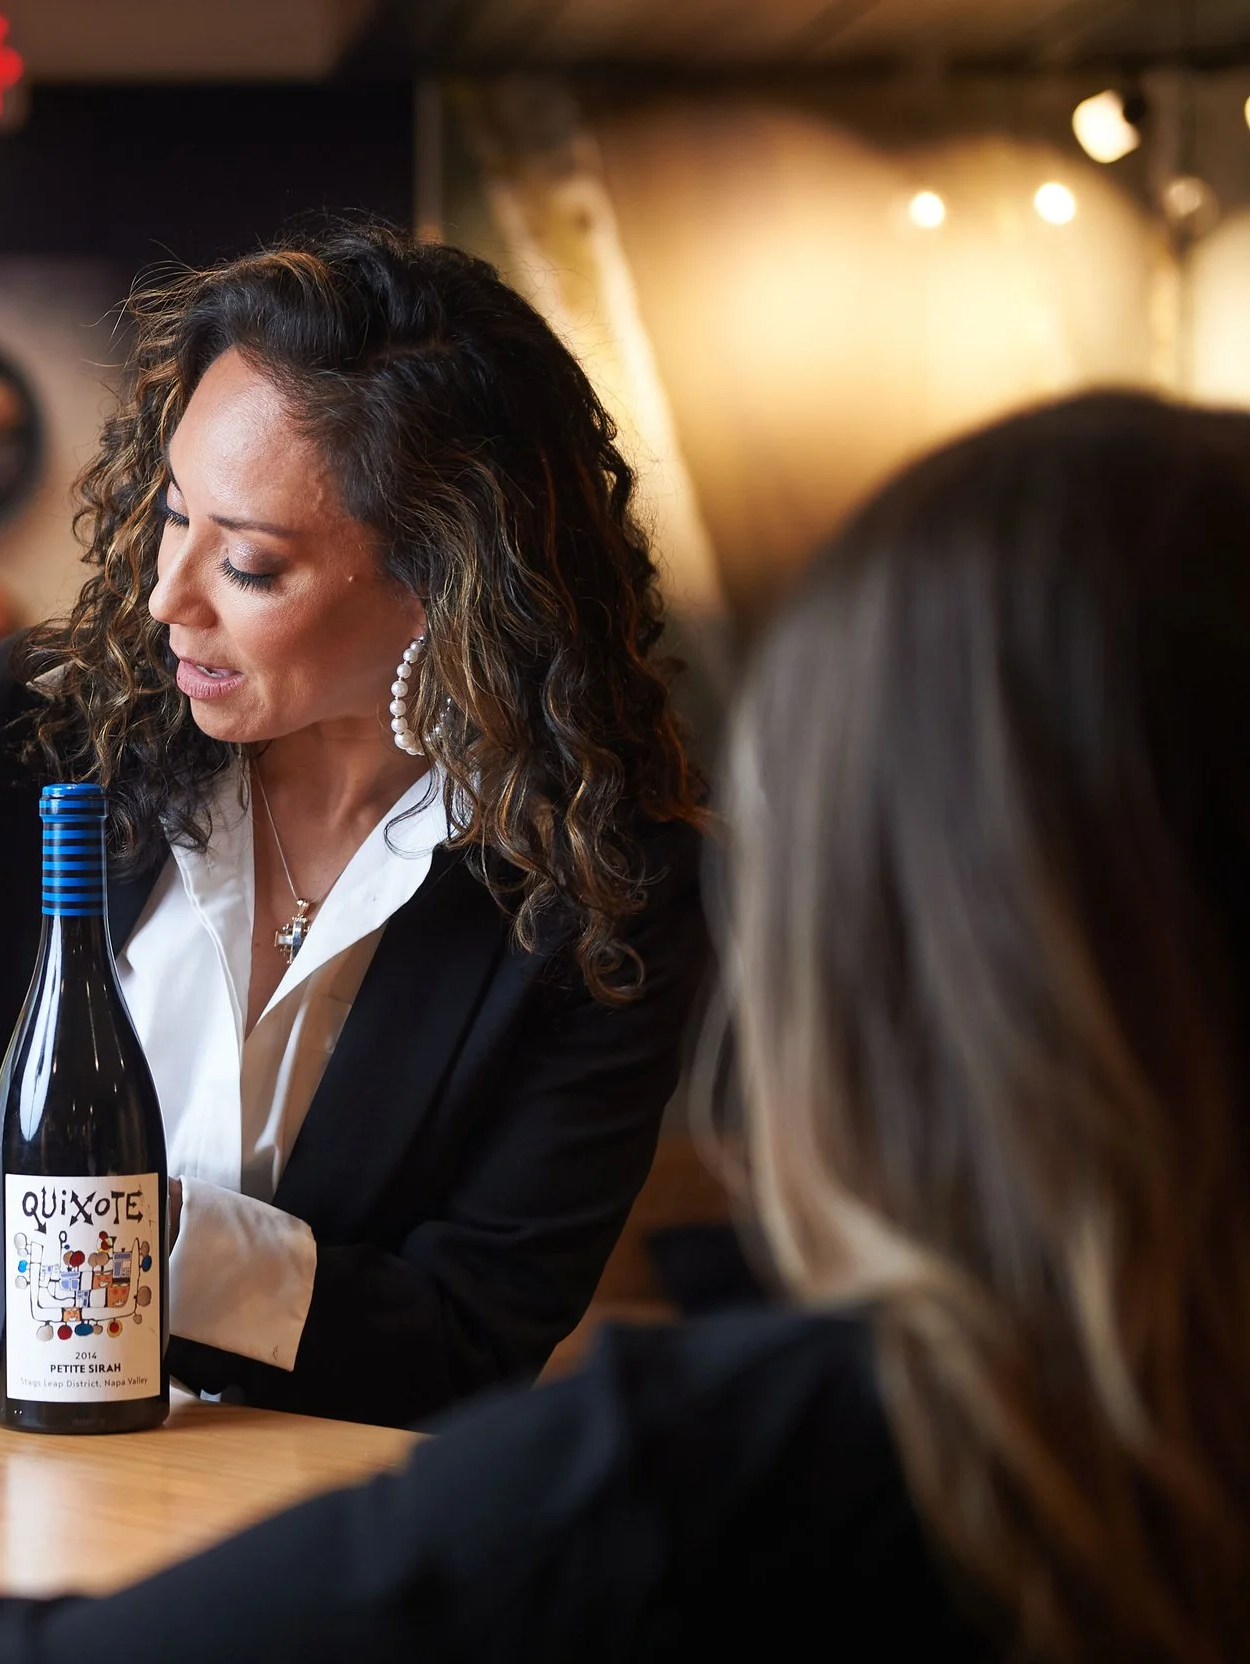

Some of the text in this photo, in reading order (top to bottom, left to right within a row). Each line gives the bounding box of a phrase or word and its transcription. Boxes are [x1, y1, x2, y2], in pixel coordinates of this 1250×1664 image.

[75, 1351, 97, 1360] 2014
[50, 1362, 122, 1373] PETITE SIRAH
[20, 1376, 148, 1389] Stags Leap District, Napa Valley
